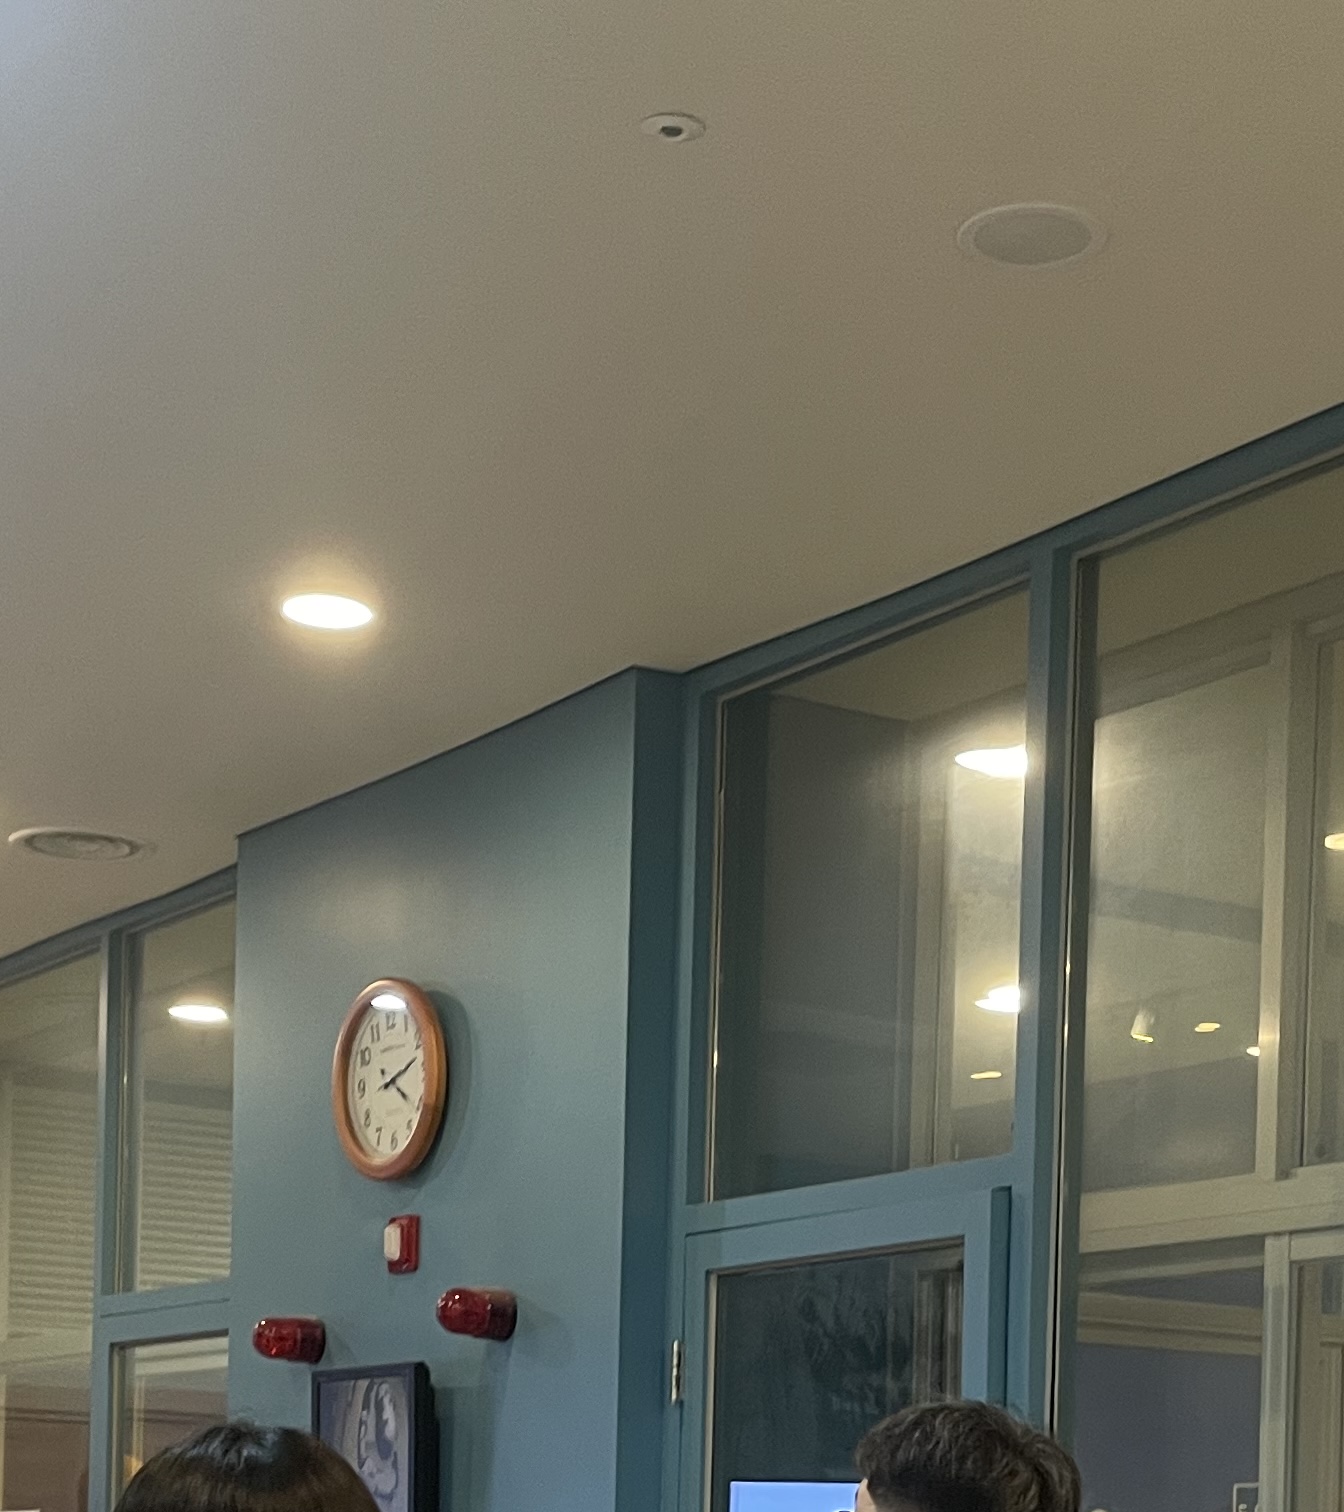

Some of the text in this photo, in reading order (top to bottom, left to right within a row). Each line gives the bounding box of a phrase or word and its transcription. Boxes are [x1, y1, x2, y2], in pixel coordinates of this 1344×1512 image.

[370, 1021, 381, 1043] 11
[385, 1011, 397, 1031] 12
[360, 1046, 371, 1068] 10
[357, 1078, 366, 1100] 9
[363, 1108, 371, 1129] 8
[375, 1126, 383, 1147] 7
[390, 1130, 398, 1152] 6
